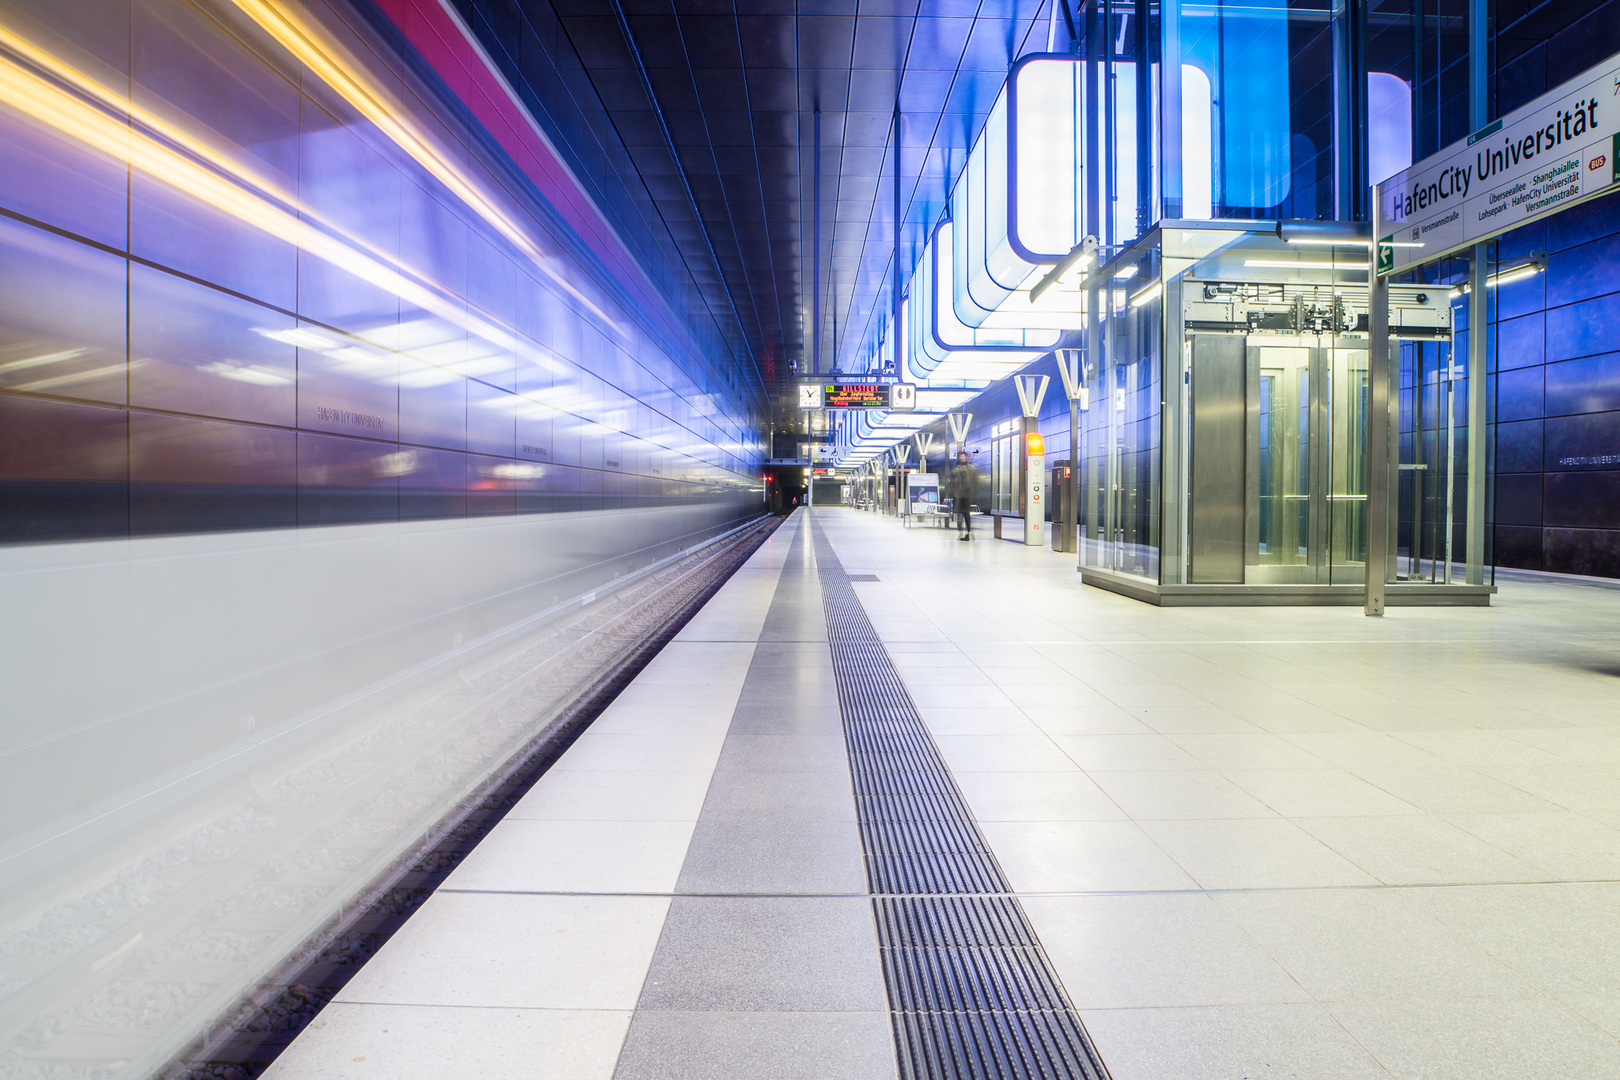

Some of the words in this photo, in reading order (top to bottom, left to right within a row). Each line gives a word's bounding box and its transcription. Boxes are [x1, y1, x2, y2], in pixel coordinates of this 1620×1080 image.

[1393, 164, 1472, 222] HafenCity
[1477, 97, 1598, 182] Universität
[1591, 157, 1604, 169] BUS
[1478, 201, 1508, 222] Lohsepark
[1511, 187, 1542, 208] HafenCity
[1542, 171, 1580, 195] Universität
[1488, 182, 1527, 205] Überseeallee
[1532, 159, 1580, 187] Shanghaiallee
[1525, 184, 1580, 213] Versmannstraße
[1420, 210, 1460, 234] Versmannstraße
[318, 406, 350, 424] HAFENCITY
